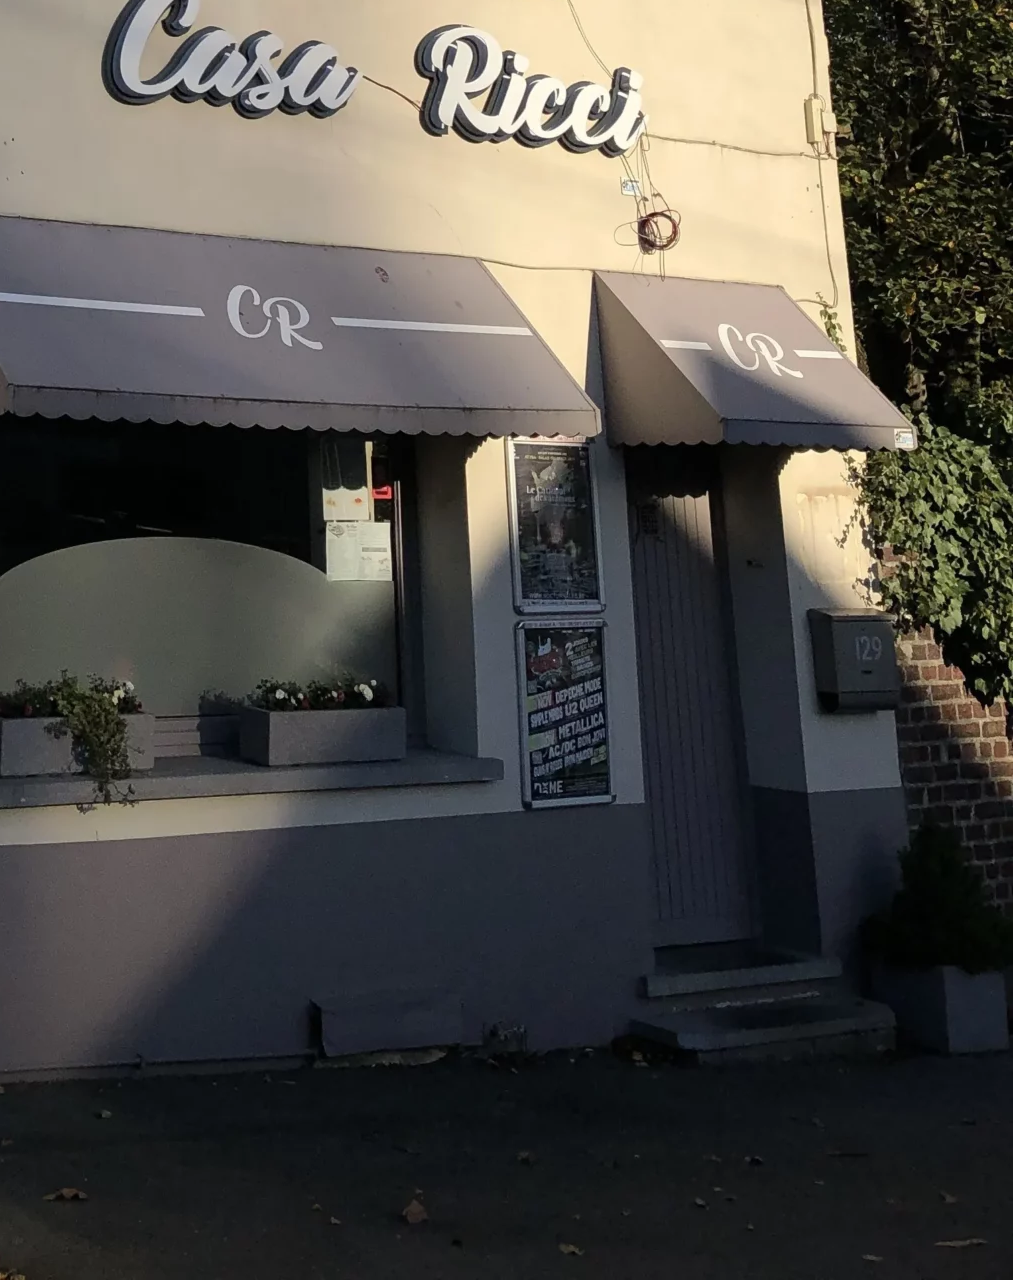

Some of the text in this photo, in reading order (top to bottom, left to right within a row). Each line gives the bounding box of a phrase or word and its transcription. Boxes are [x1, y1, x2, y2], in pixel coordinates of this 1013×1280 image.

[414, 24, 649, 158] Ricci
[227, 285, 323, 350] CR
[717, 323, 803, 378] CR
[855, 636, 882, 660] 129
[565, 701, 578, 717] U2
[579, 691, 603, 713] QUEEN
[558, 711, 604, 740] METALLICA
[548, 739, 576, 760] AC/DC
